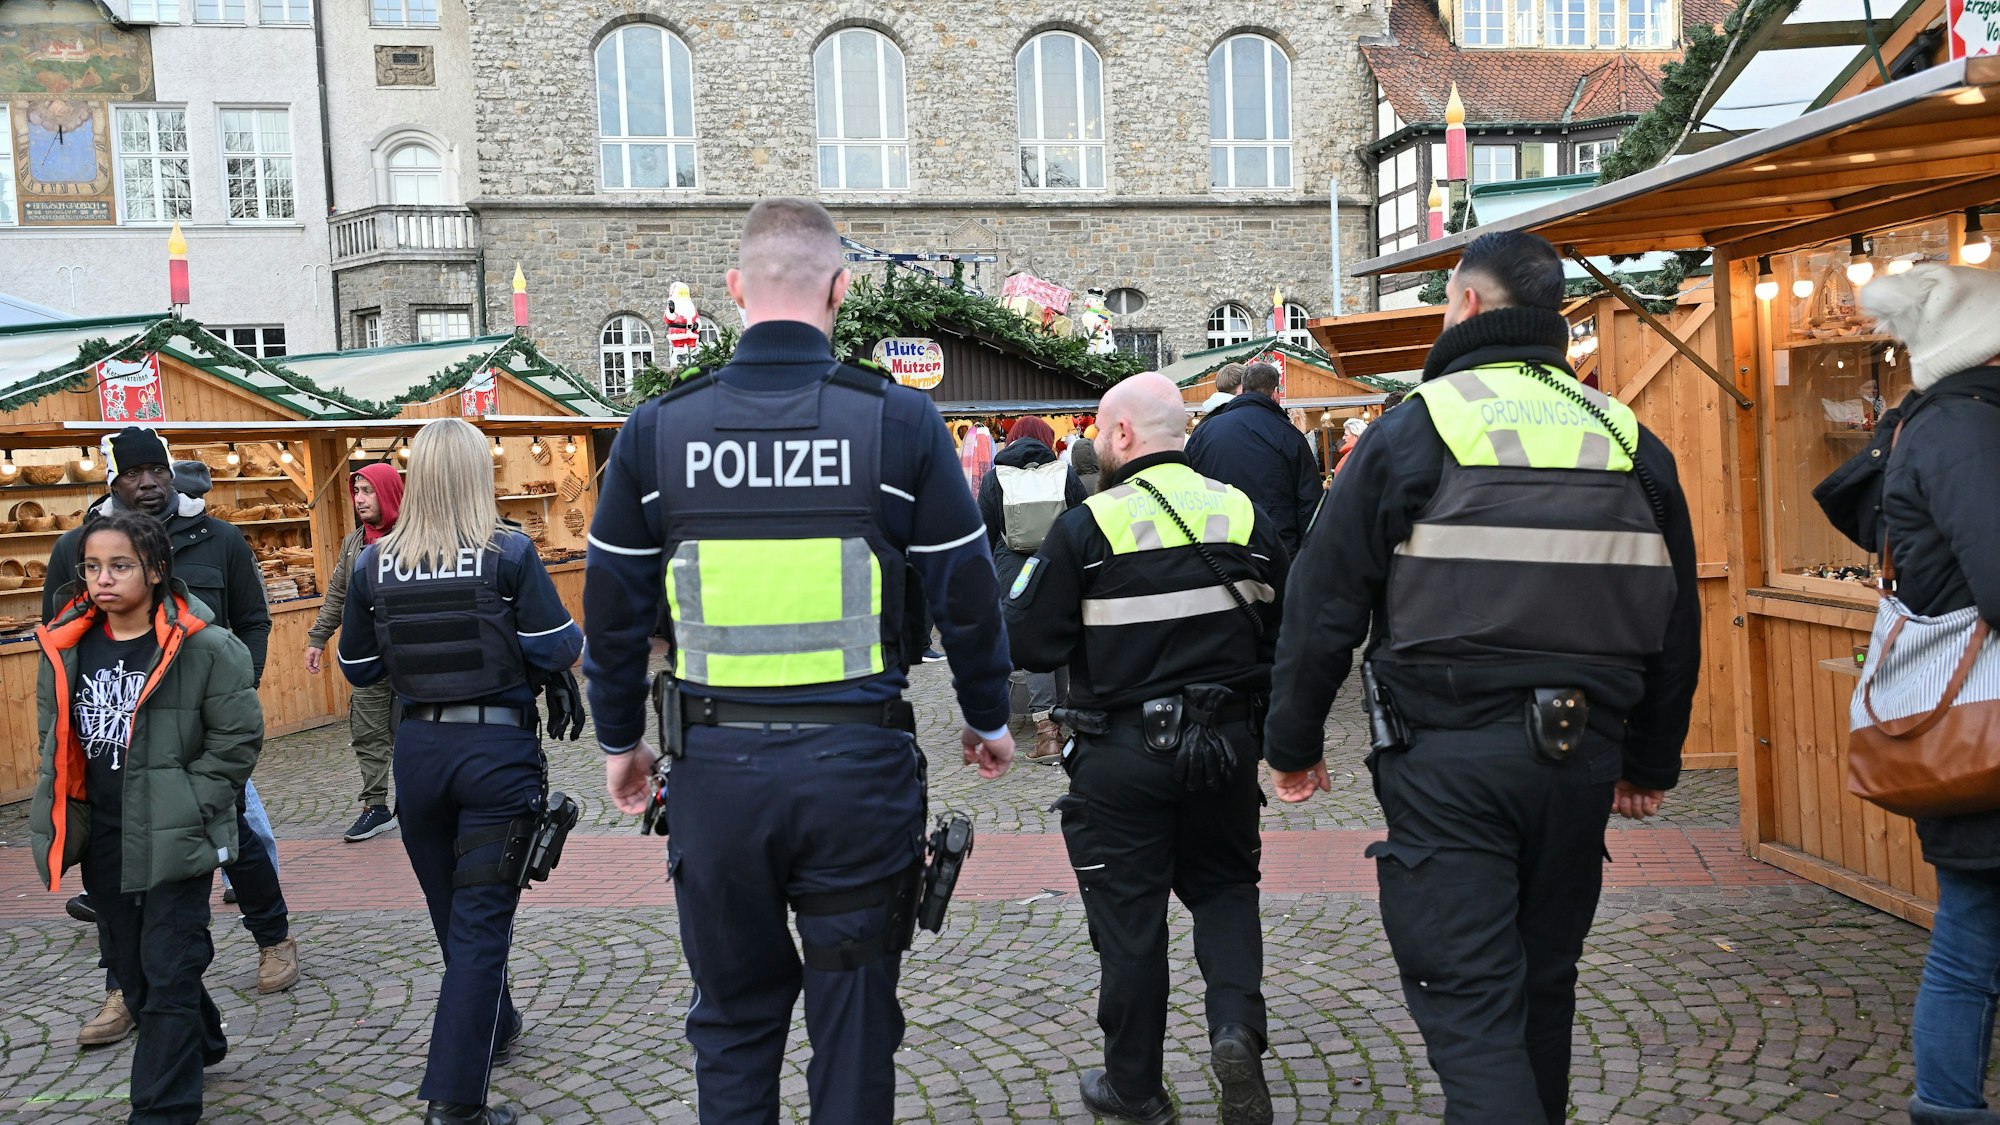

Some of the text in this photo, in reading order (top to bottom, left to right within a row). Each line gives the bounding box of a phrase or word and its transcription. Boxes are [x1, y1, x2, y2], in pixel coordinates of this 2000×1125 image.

[1965, 0, 2000, 21] Erzge
[884, 340, 925, 357] Hüte
[892, 358, 941, 374] Mützen
[901, 374, 942, 388] Warmes
[686, 439, 851, 488] POLIZEI
[378, 547, 483, 584] POLIZEI
